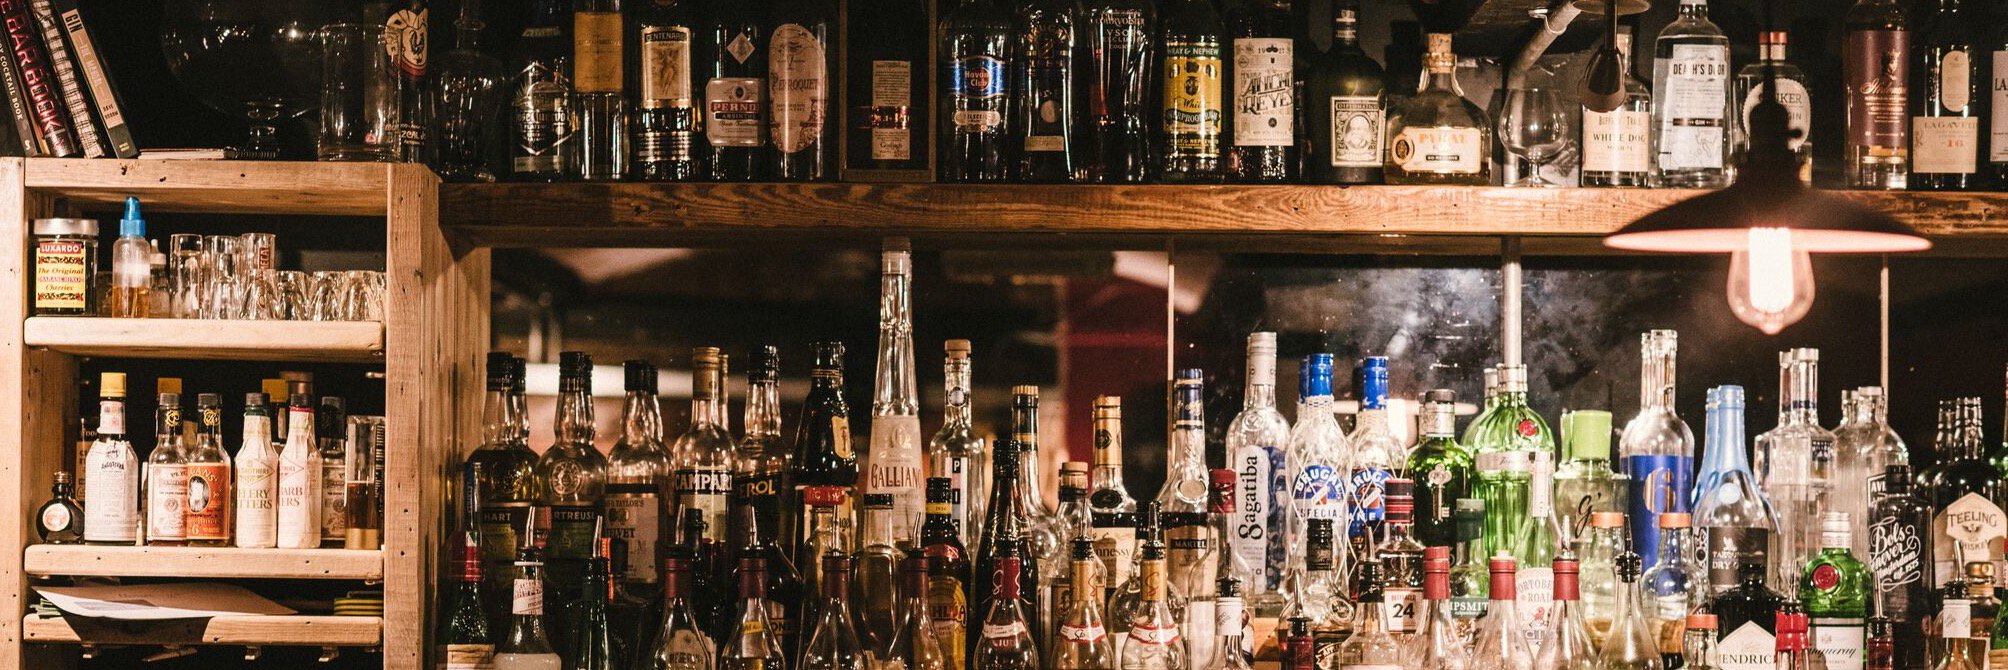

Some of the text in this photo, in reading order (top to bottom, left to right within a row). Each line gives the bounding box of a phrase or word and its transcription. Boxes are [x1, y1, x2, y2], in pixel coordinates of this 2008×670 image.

[66, 13, 83, 33] GIN
[1673, 64, 1705, 75] DEAH'S
[0, 55, 24, 121] COCKTAIL BOOK
[971, 79, 988, 87] Club
[713, 103, 757, 111] PERNO
[1593, 133, 1622, 142] WHIE
[41, 244, 80, 253] LUXARDO
[51, 267, 84, 276] Original
[46, 284, 74, 292] Cherries
[675, 474, 733, 491] CAMPARI
[1238, 455, 1264, 540] Sagatiba
[1950, 511, 1997, 528] TEELING
[1869, 522, 1906, 561] Bols
[1713, 561, 1731, 570] DRY
[1393, 603, 1415, 619] 24
[1450, 601, 1488, 611] IPSMIT
[1722, 654, 1772, 665] ENDRIC
